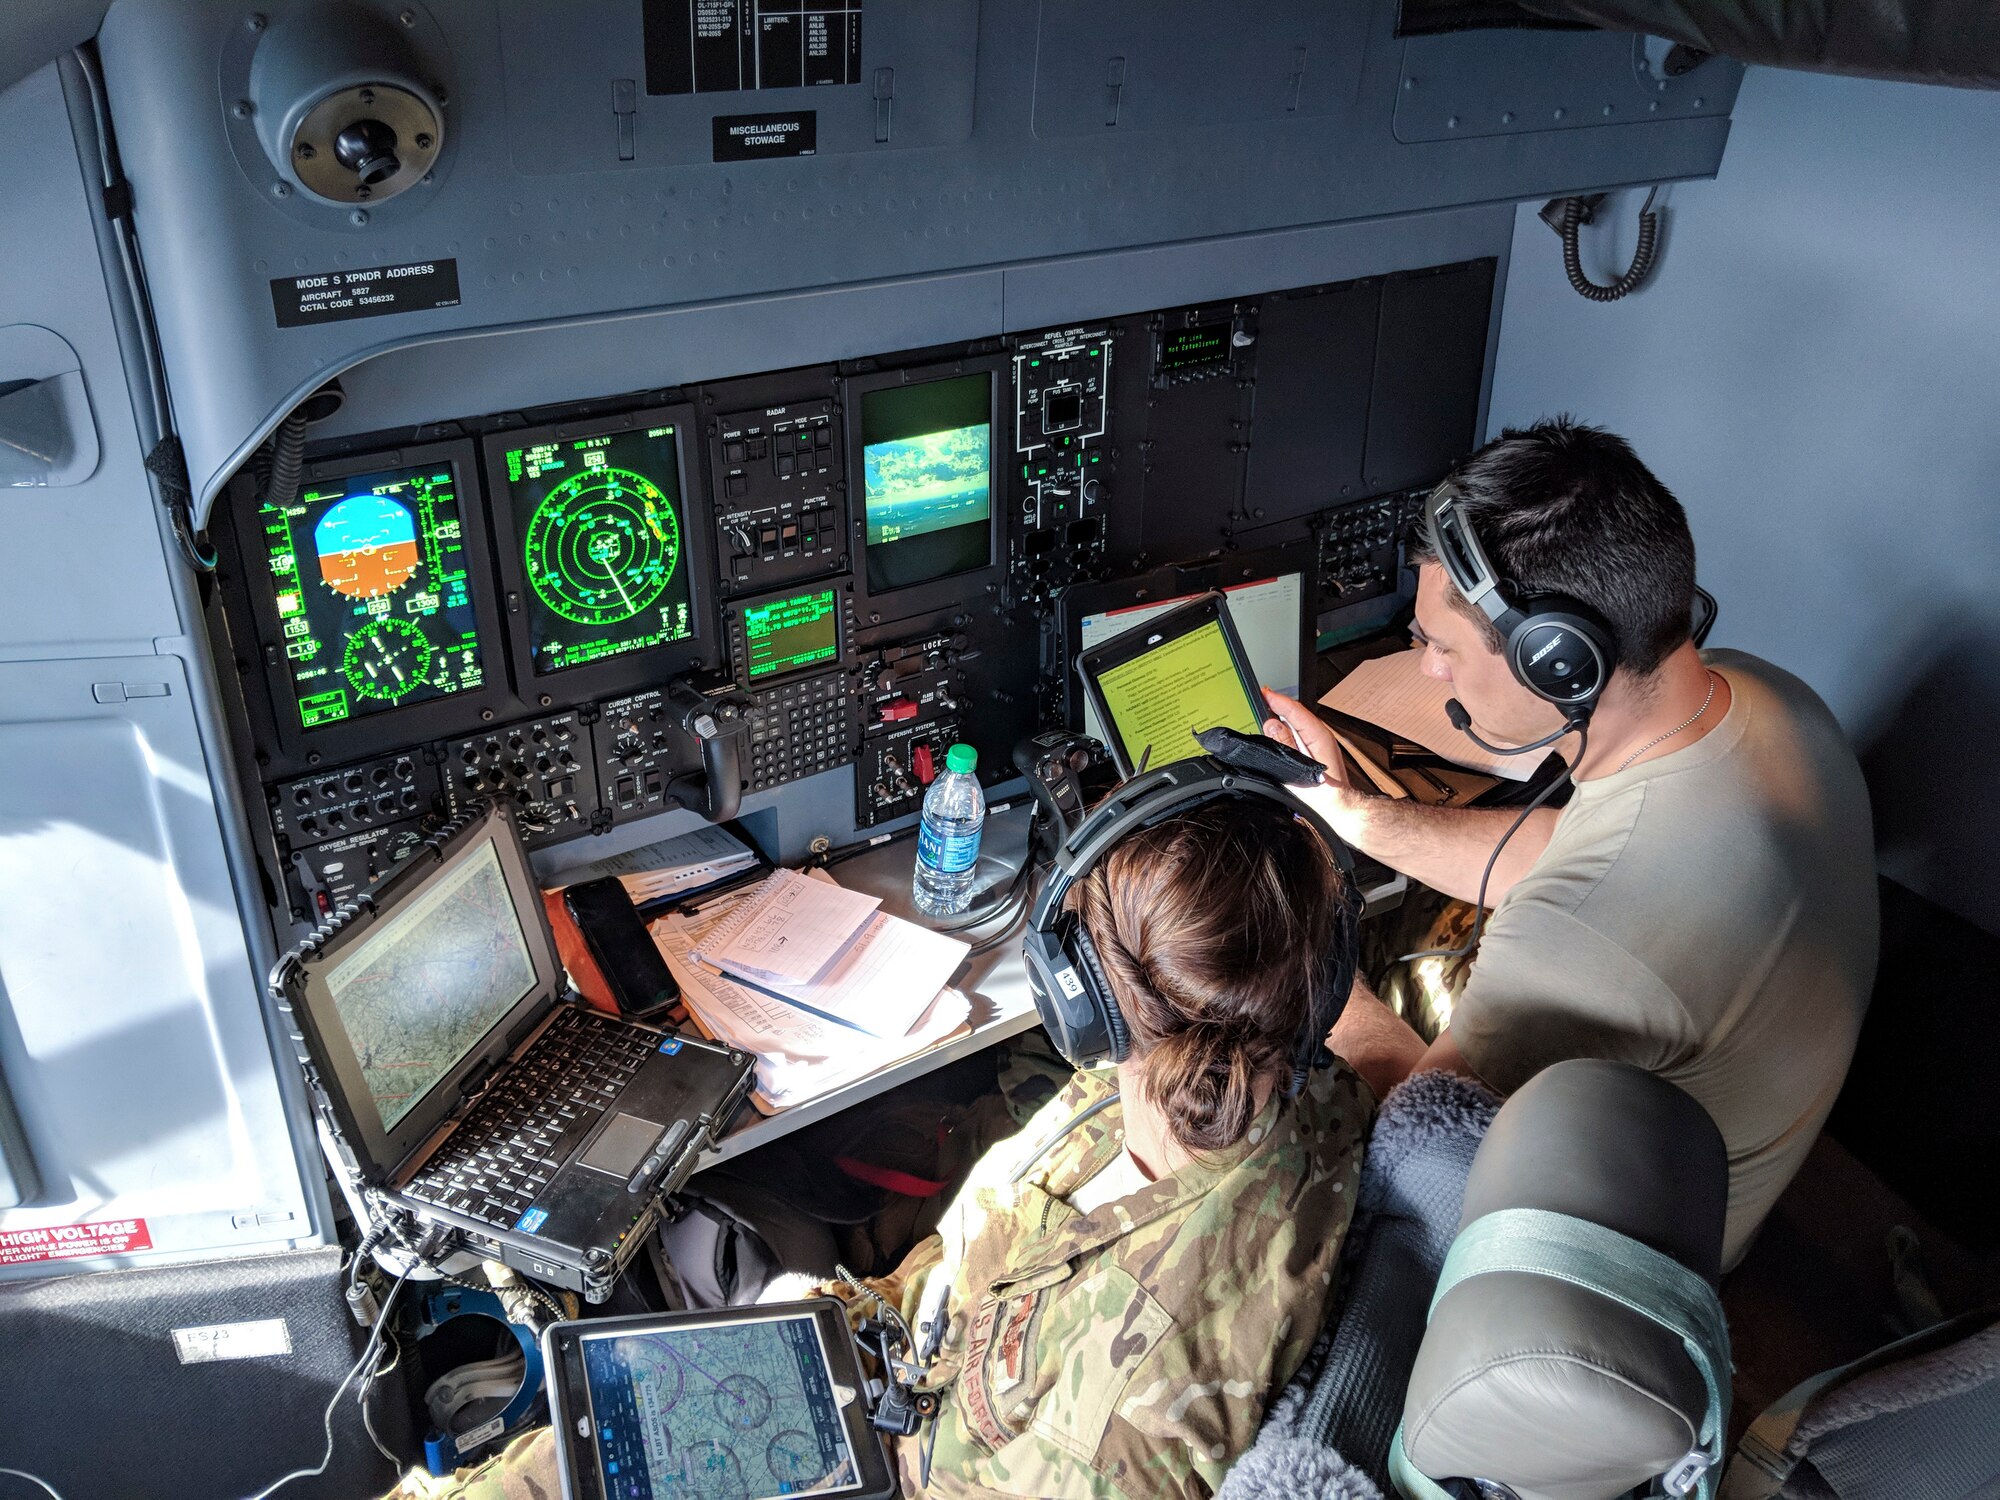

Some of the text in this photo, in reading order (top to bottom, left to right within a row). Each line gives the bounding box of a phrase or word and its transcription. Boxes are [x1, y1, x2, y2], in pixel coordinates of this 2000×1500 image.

[730, 123, 799, 135] MISCELLANEOUS
[745, 135, 785, 145] STOWAGE
[297, 265, 435, 289] MODE S XPNDR ADDRESS
[301, 287, 370, 302] AIRCRAFT 5827
[300, 295, 395, 312] OCTAL CODE 53456232
[1065, 328, 1084, 336] CONTROL
[767, 408, 785, 416] RADAR
[724, 431, 741, 439] POWER
[804, 496, 826, 504] FUNCTION
[923, 639, 942, 650] LOCK
[1529, 633, 1562, 666] BOSE
[608, 691, 661, 709] CURSOR CONTROL
[888, 722, 935, 740] DEFENSIVE SYSTEMS
[313, 774, 340, 785] TACAN-1
[319, 803, 347, 815] TACAN-2
[275, 809, 285, 830] MON
[318, 828, 389, 852] OXYGEN REGULATOR
[326, 874, 344, 883] FLOW
[1063, 972, 1078, 991] 439
[1, 1221, 138, 1246] HIGH VOLTAGE
[21, 1243, 56, 1253] WHILE
[59, 1238, 99, 1250] POWER
[48, 1244, 126, 1258] EMERGENCIES
[964, 1338, 986, 1374] AIR
[965, 1377, 1009, 1450] FORCE
